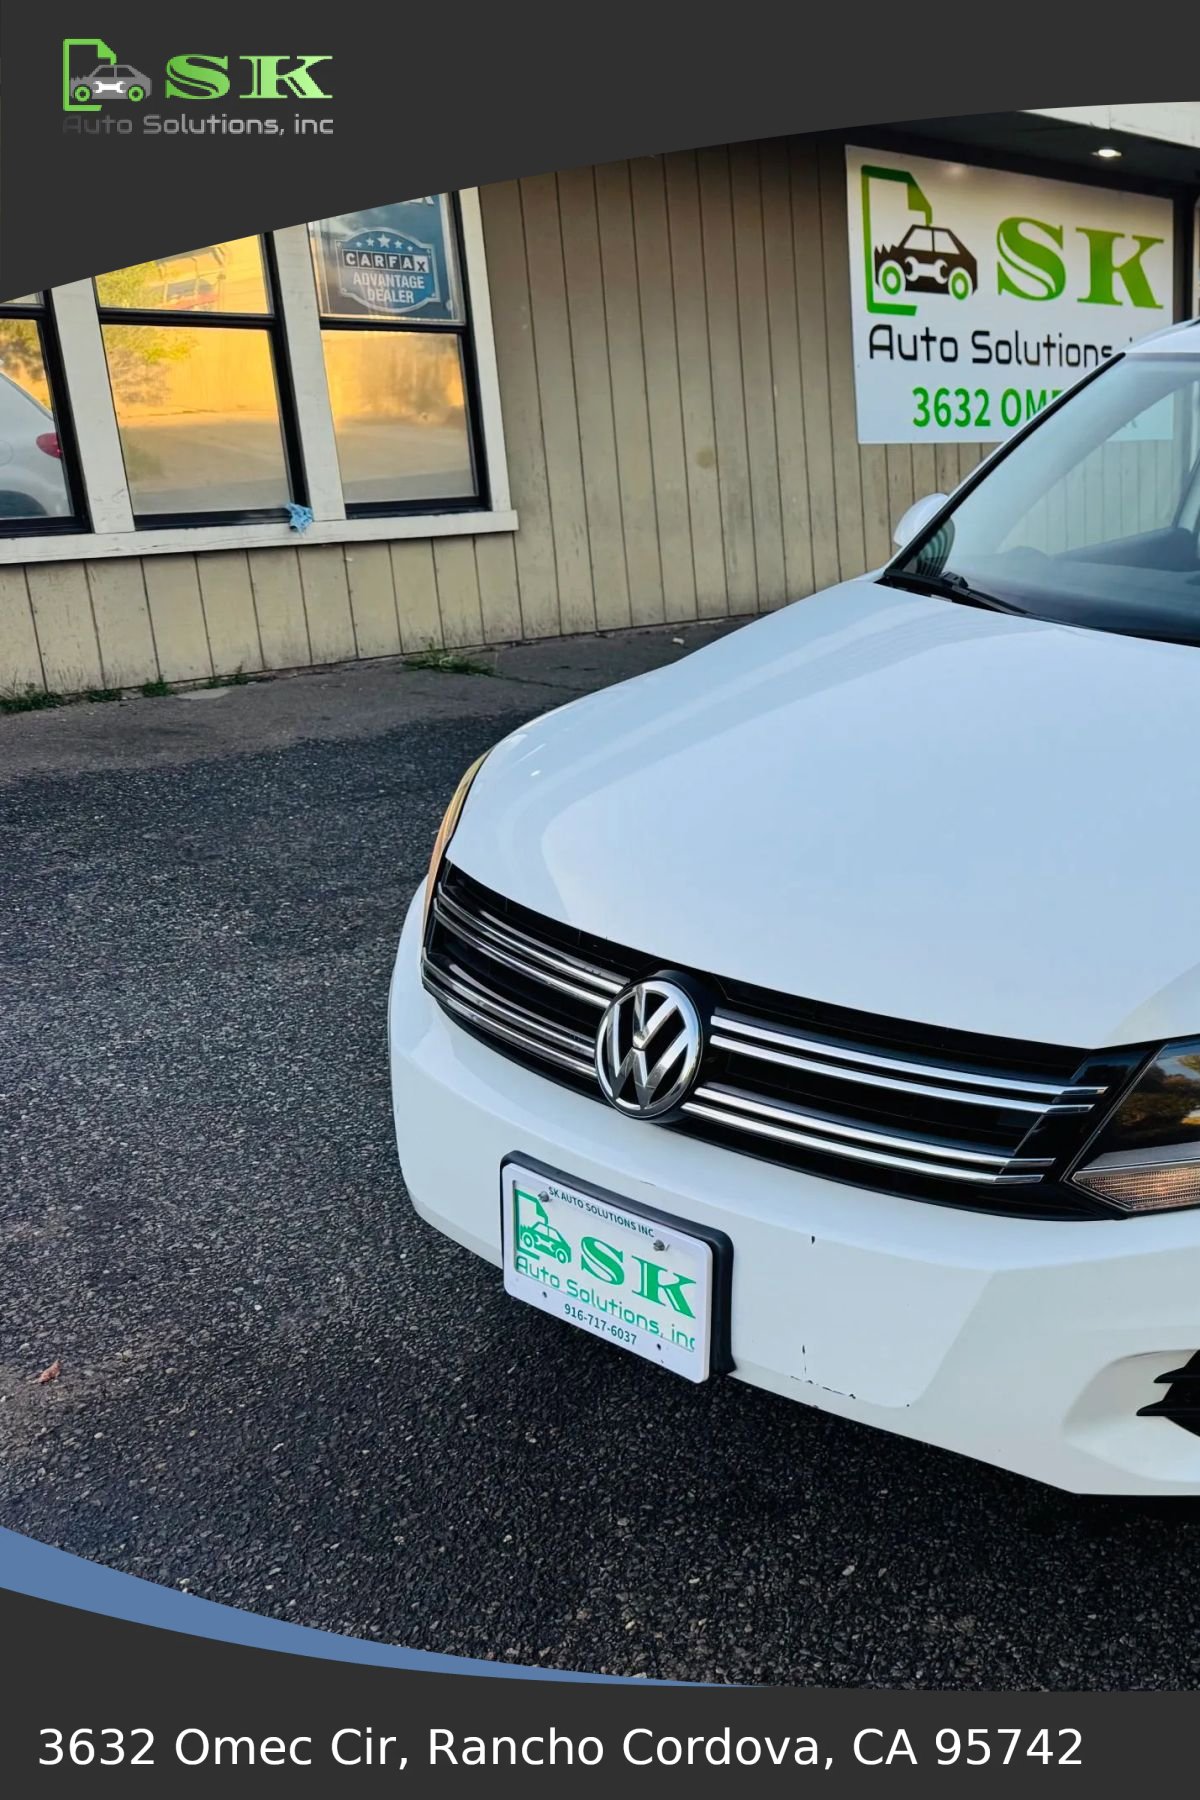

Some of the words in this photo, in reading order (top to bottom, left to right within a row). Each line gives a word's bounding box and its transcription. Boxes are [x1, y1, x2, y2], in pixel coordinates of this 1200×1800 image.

[345, 252, 427, 273] CARFAX
[353, 272, 425, 289] ADVANTAGE
[996, 216, 1164, 309] SK
[367, 287, 415, 304] DEALER
[869, 323, 959, 363] Auto
[912, 386, 991, 429] 3632
[1001, 388, 1063, 428] OM
[548, 1186, 560, 1199] SK
[561, 1194, 584, 1209] AUTO
[585, 1203, 637, 1231] SOLUTIONS
[637, 1225, 655, 1238] INC
[516, 1255, 560, 1289] Auto
[580, 1236, 697, 1319] SK
[564, 1303, 637, 1345] 916-717-6037
